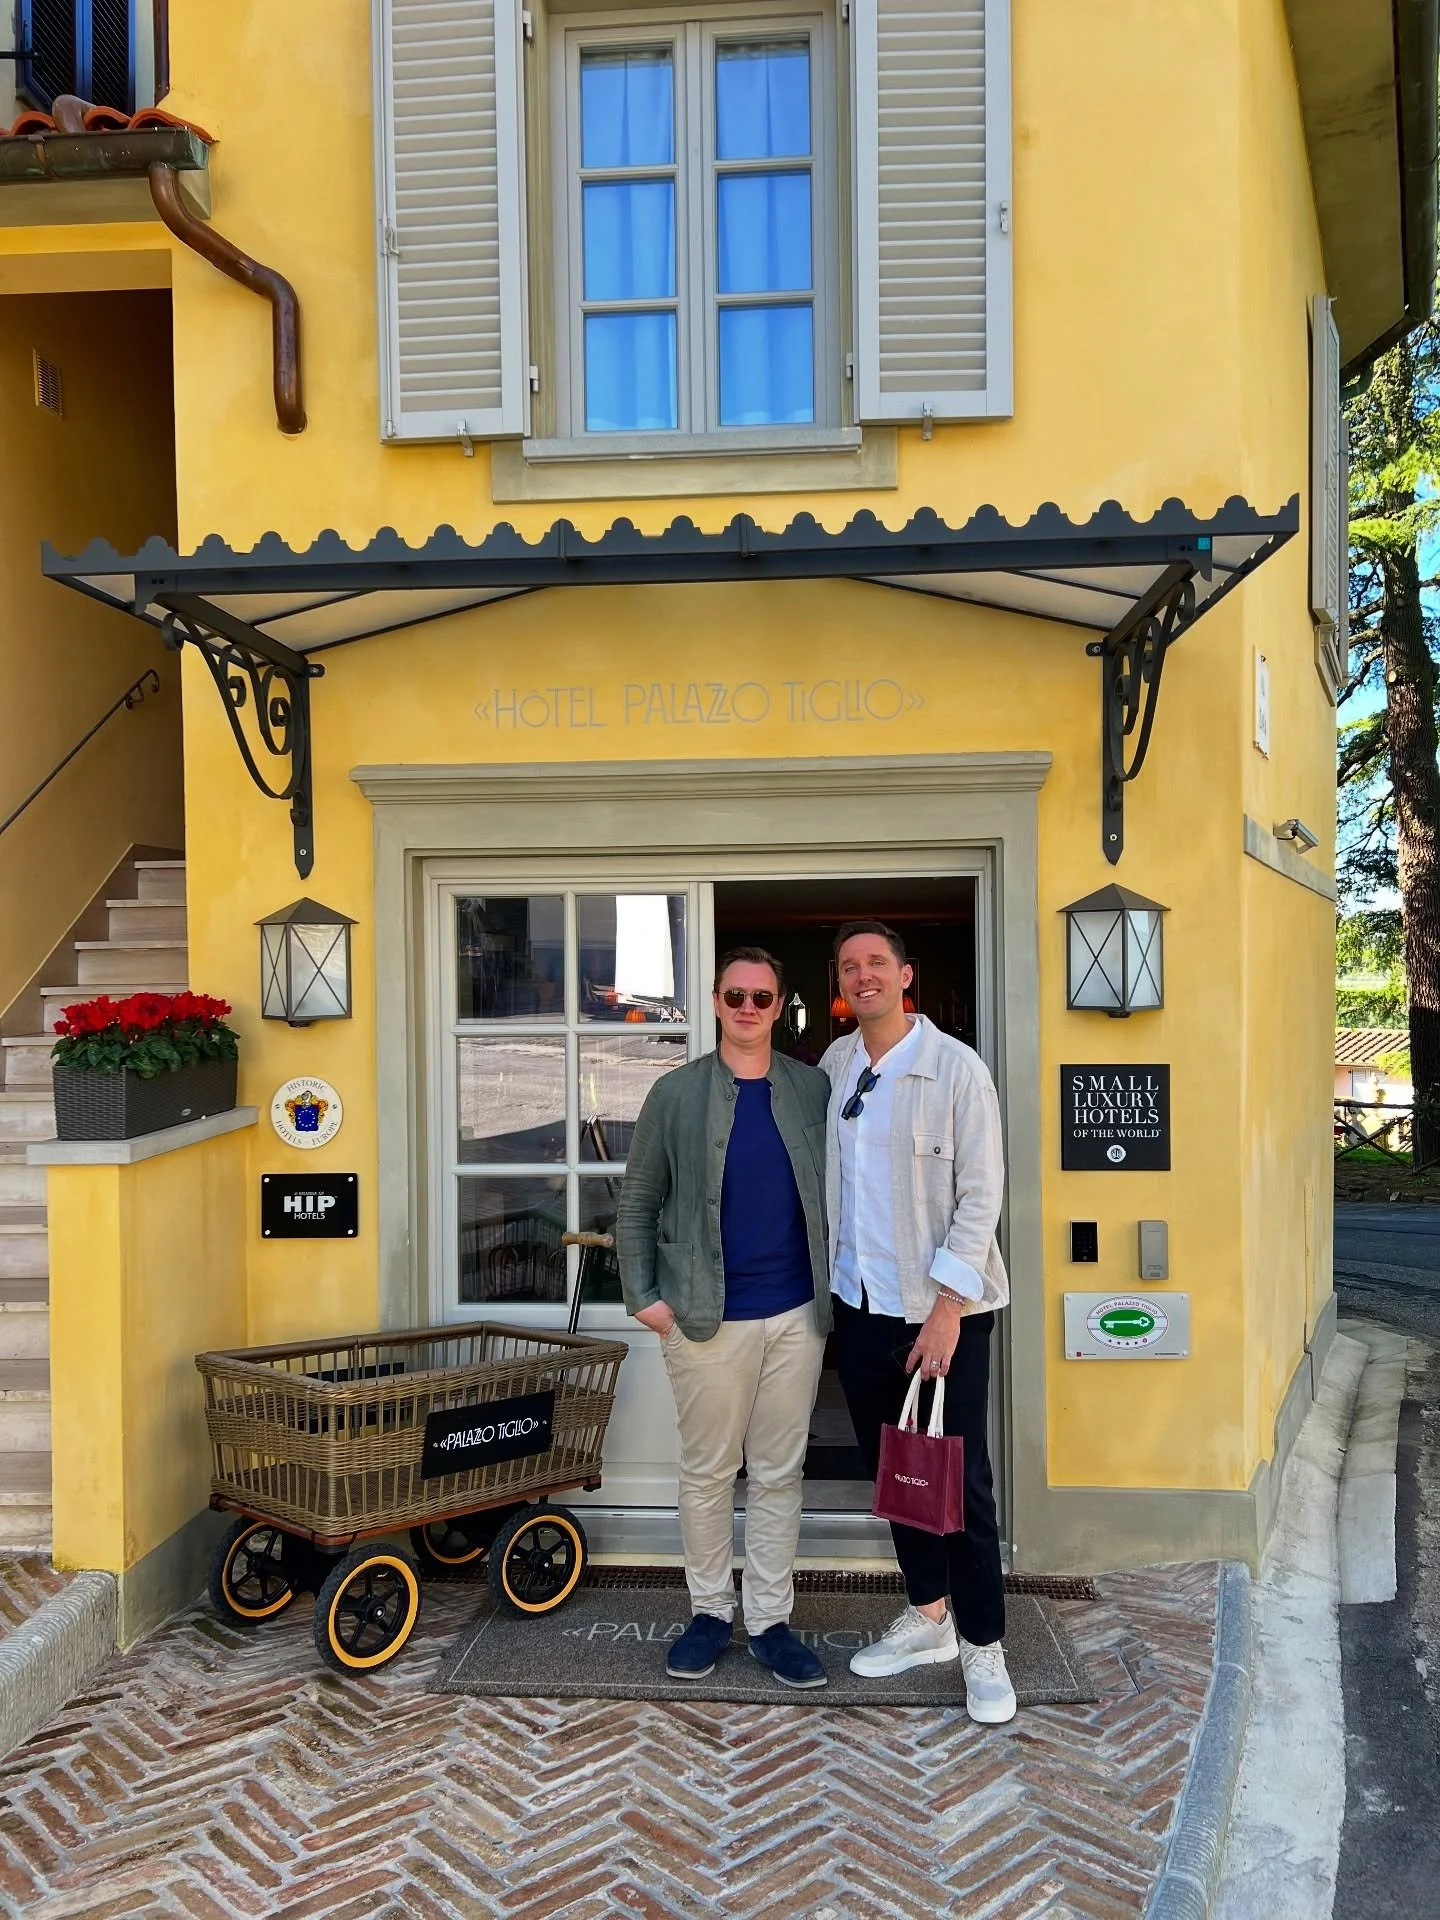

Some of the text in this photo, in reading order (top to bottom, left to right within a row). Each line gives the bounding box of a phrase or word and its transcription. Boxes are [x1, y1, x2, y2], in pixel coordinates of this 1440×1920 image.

[624, 682, 770, 725] PALAZZO
[286, 1080, 328, 1092] HISTORIC
[1072, 1075, 1159, 1091] SMALL
[1073, 1092, 1159, 1107] LUXURY
[1074, 1108, 1159, 1124] HOTELS
[1073, 1129, 1089, 1138] OF
[1091, 1129, 1114, 1138] THE
[284, 1195, 336, 1212] HIP
[294, 1212, 326, 1220] HOTELS
